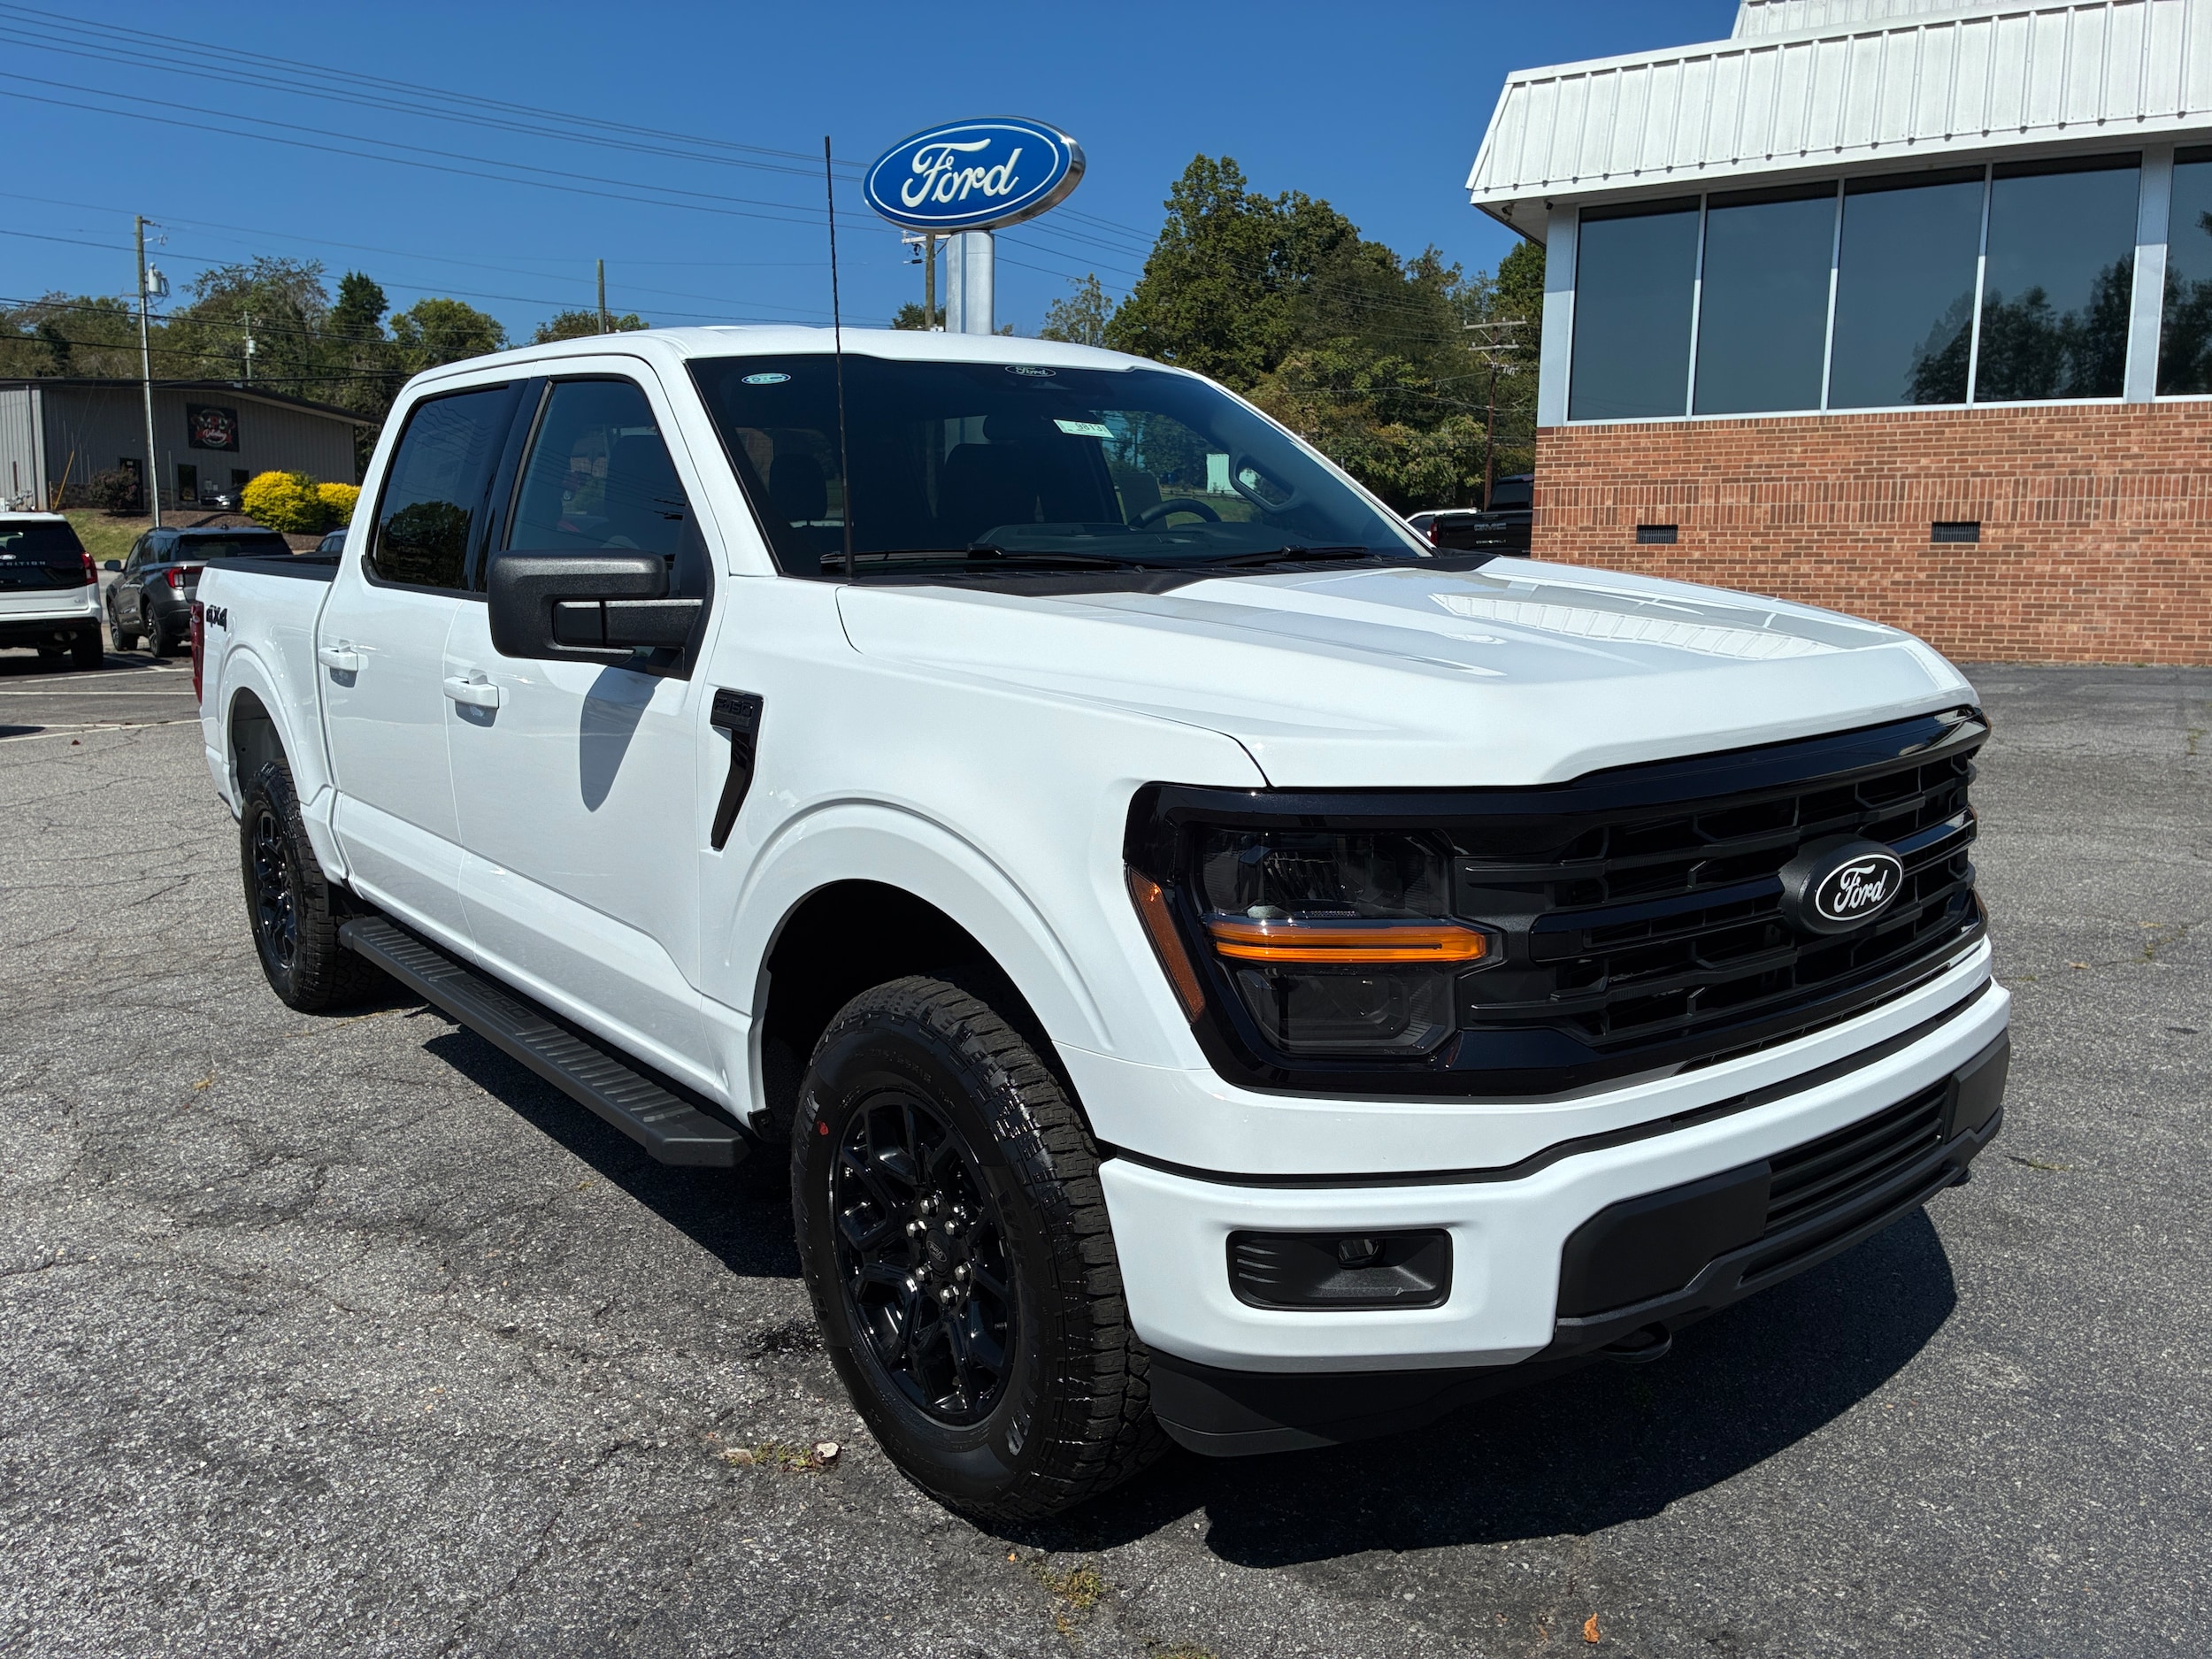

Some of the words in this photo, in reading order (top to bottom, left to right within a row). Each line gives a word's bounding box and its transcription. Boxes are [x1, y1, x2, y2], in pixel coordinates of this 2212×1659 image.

[901, 138, 1023, 208] Ford
[1015, 366, 1048, 376] Ford
[1474, 522, 1507, 531] GMC
[1833, 864, 1888, 913] Ford
